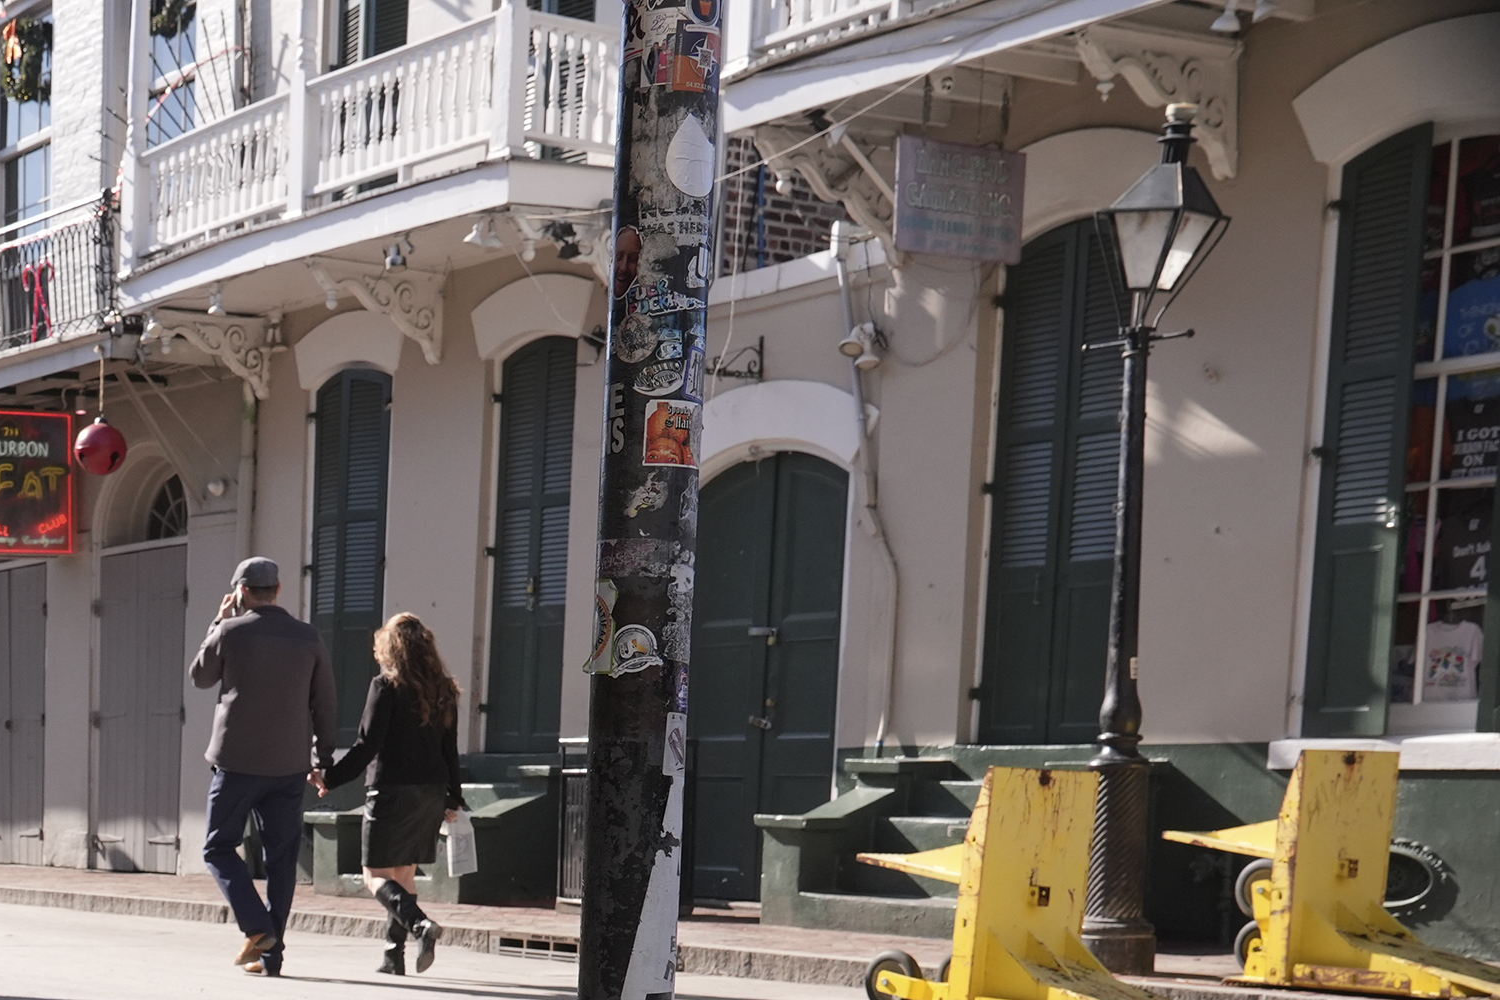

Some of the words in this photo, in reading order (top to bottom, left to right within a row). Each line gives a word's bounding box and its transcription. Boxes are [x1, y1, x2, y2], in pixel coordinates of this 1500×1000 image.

[1466, 425, 1500, 441] GOT
[1462, 453, 1485, 467] ON
[38, 513, 68, 534] CLUB
[1469, 555, 1487, 581] 4
